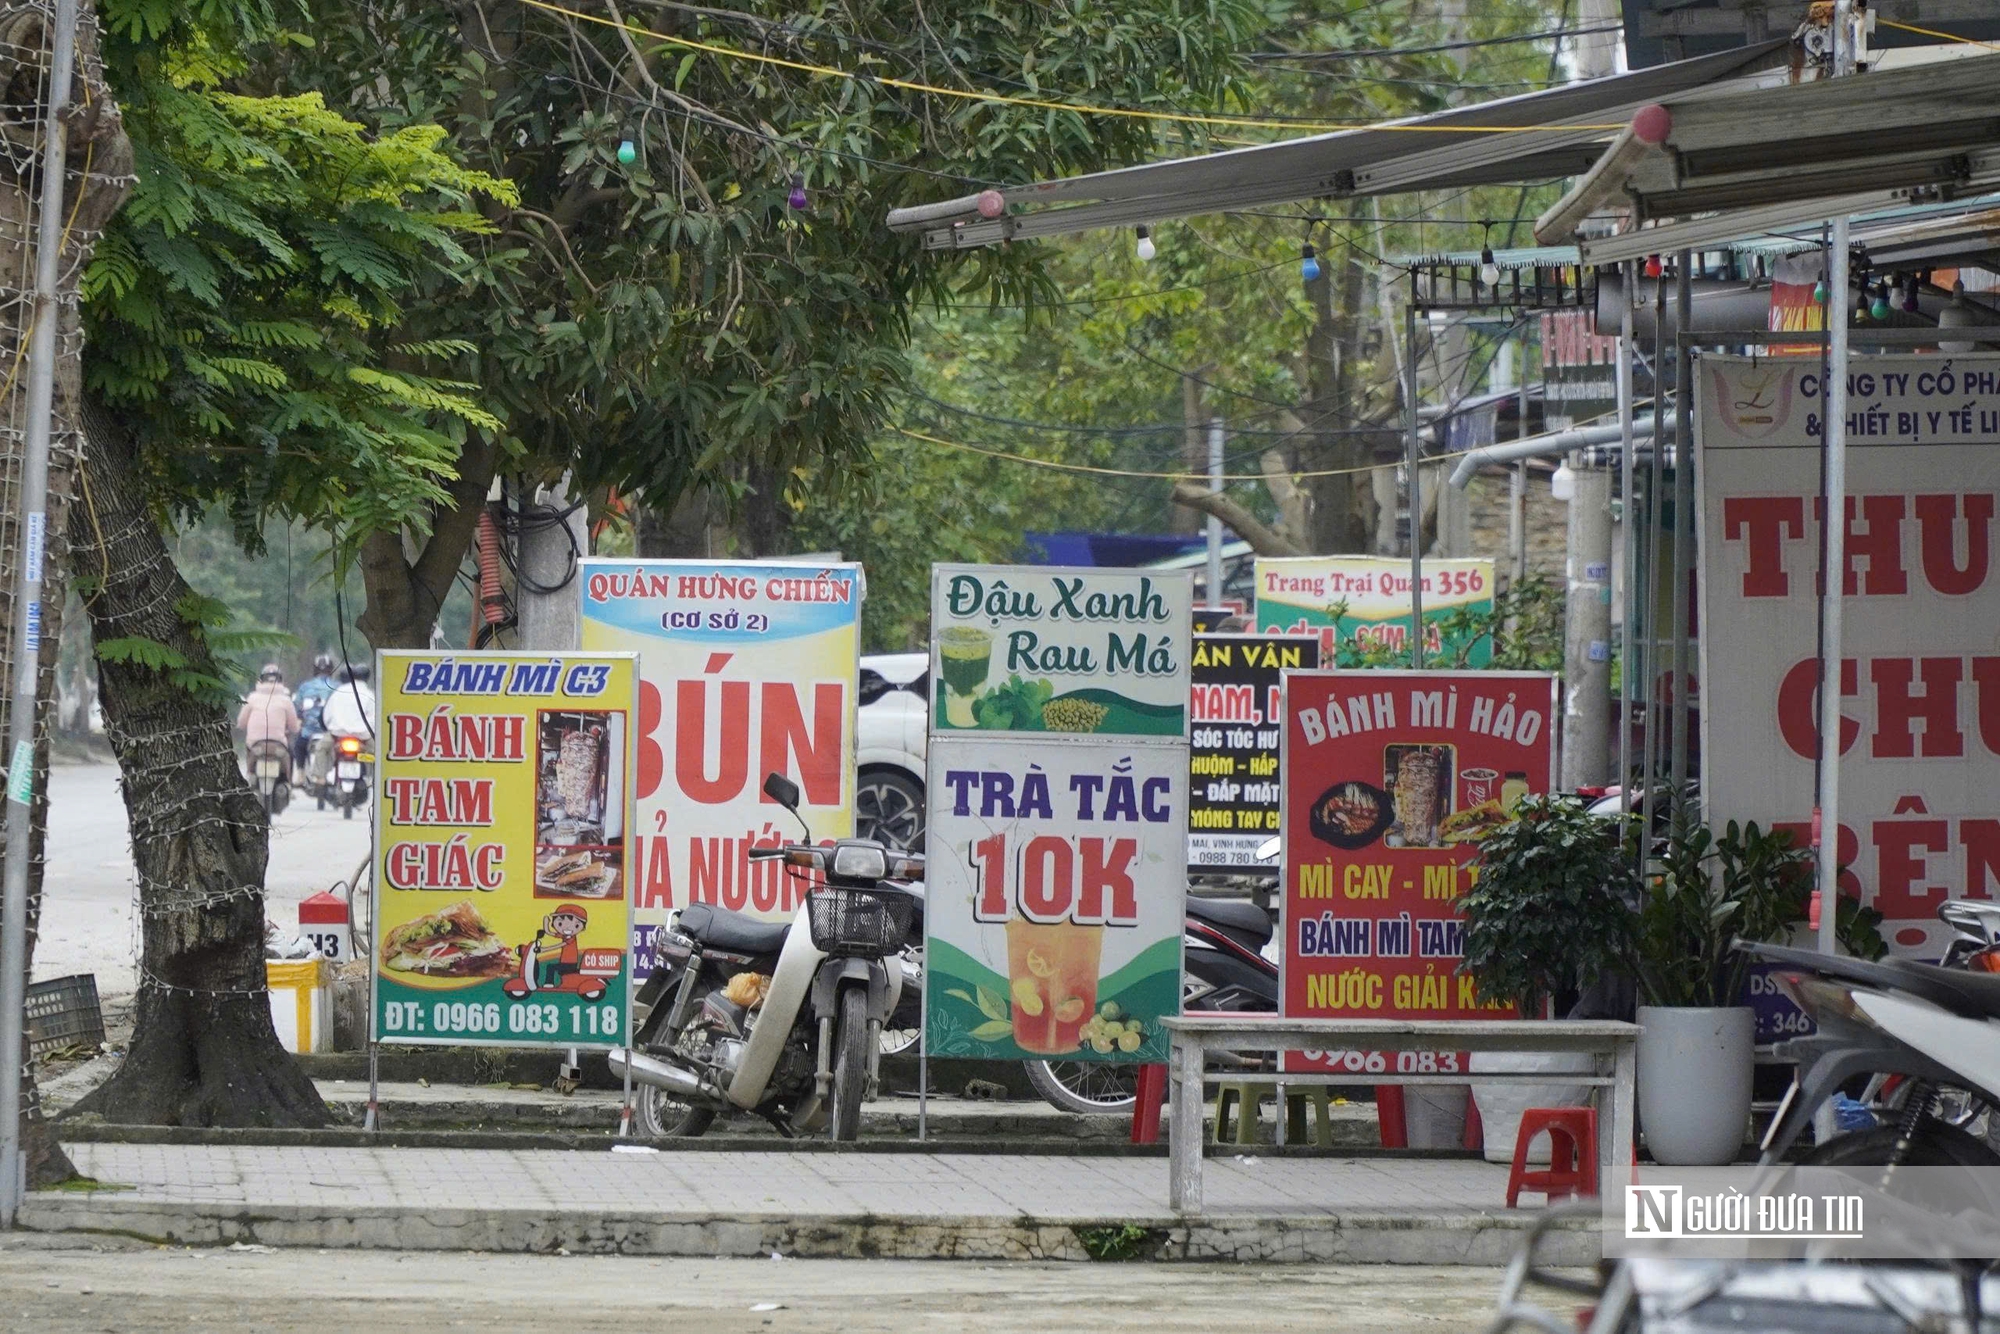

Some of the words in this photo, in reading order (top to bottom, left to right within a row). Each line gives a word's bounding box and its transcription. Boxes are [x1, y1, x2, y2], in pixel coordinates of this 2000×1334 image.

[1882, 373, 1909, 396] TY
[1917, 359, 1956, 396] CỔ
[1964, 368, 2000, 395] PH
[1806, 413, 1821, 437] &
[1845, 402, 1890, 436] HIẾT
[1898, 412, 1918, 442] BỊ
[1926, 411, 1941, 434] Y
[1948, 400, 1976, 434] TẾ
[1981, 410, 2000, 434] LI
[1724, 493, 1995, 598] THU
[588, 568, 669, 602] QUÁN
[677, 572, 758, 601] HƯNG
[764, 569, 851, 603] CHIẾN
[946, 575, 1042, 625] Đậu
[1050, 577, 1169, 620] Xanh
[1265, 573, 1325, 596] Trang
[1331, 573, 1373, 598] Trại
[1438, 570, 1483, 595] 356
[661, 611, 701, 630] (CƠ
[708, 608, 739, 630] SỞ
[746, 614, 768, 631] 2)
[1007, 630, 1098, 672] Rau
[1106, 632, 1177, 673] Má
[1241, 642, 1300, 669] VÂN
[405, 655, 506, 694] BÁNH
[511, 658, 561, 694] MÌ
[565, 665, 611, 695] C3
[1191, 686, 1262, 726] NAM,
[1298, 693, 1396, 746] BÁNH
[1411, 685, 1457, 729] MÌ
[1469, 692, 1542, 746] HẢO
[391, 705, 525, 760] BÁNH
[1193, 727, 1223, 748] SÓC
[1226, 727, 1254, 749] TÓC
[1250, 751, 1278, 775] HẤP
[390, 779, 493, 824] TAM
[945, 763, 1053, 819] TRÀ
[1069, 756, 1170, 823] TẮC
[1207, 778, 1241, 802] ĐẮP
[1244, 781, 1280, 806] MẶT
[1236, 811, 1263, 828] TAY
[390, 834, 503, 889] GIÁC
[976, 833, 1138, 918] 10K
[1199, 851, 1227, 864] 0988
[1230, 852, 1250, 864] 780
[1300, 857, 1333, 899] MÌ
[1344, 864, 1394, 899] CAY
[1423, 858, 1457, 900] MÌ
[1300, 912, 1371, 957] BÁNH
[1377, 911, 1412, 957] MÌ
[584, 953, 597, 966] CÓ
[599, 955, 618, 966] SHIP
[1307, 967, 1383, 1009] NƯỚC
[1393, 963, 1448, 1009] GIẢI
[1750, 973, 1785, 996] DS
[385, 1002, 424, 1031] ĐT:
[433, 1003, 500, 1032] 0966
[509, 1004, 558, 1033] 083
[569, 1006, 618, 1035] 118
[1772, 1011, 1810, 1034] 346
[1397, 1051, 1459, 1073] 083
